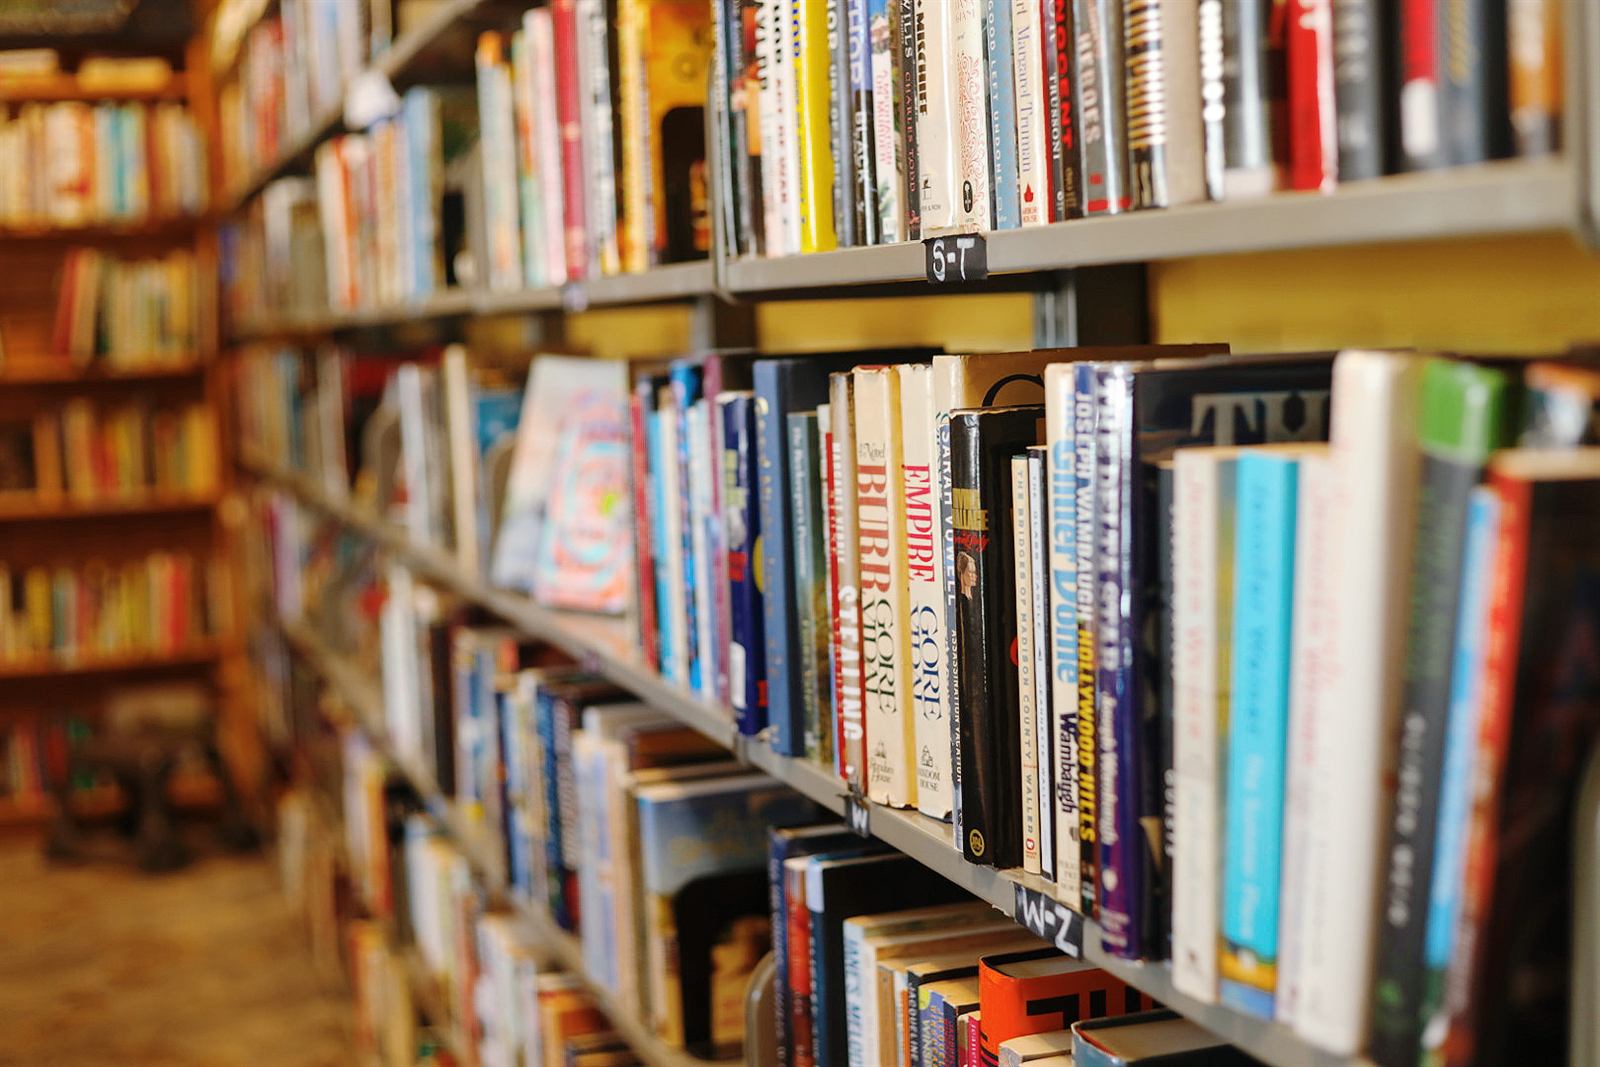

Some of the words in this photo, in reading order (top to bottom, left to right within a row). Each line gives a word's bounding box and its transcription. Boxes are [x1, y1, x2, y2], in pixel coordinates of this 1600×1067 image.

[916, 12, 928, 115] MISCHIEF
[990, 60, 999, 100] LEFT
[1016, 27, 1034, 97] Margaret
[904, 71, 914, 143] CHARLES
[1019, 102, 1035, 173] Truman
[1048, 72, 1060, 160] TRUSSONI
[907, 148, 917, 193] TODD
[993, 111, 1002, 184] UNDONE
[932, 238, 975, 282] S-T
[941, 431, 952, 504] SARAH
[1075, 391, 1093, 478] JOSEPH
[857, 463, 891, 594] BURR
[901, 463, 935, 582] EMPIRE
[1018, 508, 1026, 580] BRIDGES
[1077, 487, 1094, 621] WAMBAUGH
[944, 514, 955, 606] VOWELL
[1020, 587, 1027, 607] OF
[838, 585, 863, 741] STEALING
[876, 599, 897, 714] GORE
[919, 606, 942, 719] GORE
[1020, 612, 1029, 686] MADISON
[1053, 570, 1078, 684] Dome
[1023, 695, 1031, 760] COUNTY
[1079, 628, 1096, 769] HOLLYWOOD
[1057, 712, 1078, 814] Wambaugh
[1026, 774, 1034, 833] WALLER
[1079, 773, 1096, 842] HILLS
[1018, 886, 1079, 958] W-Z
[908, 983, 919, 1062] JACQUELINE
